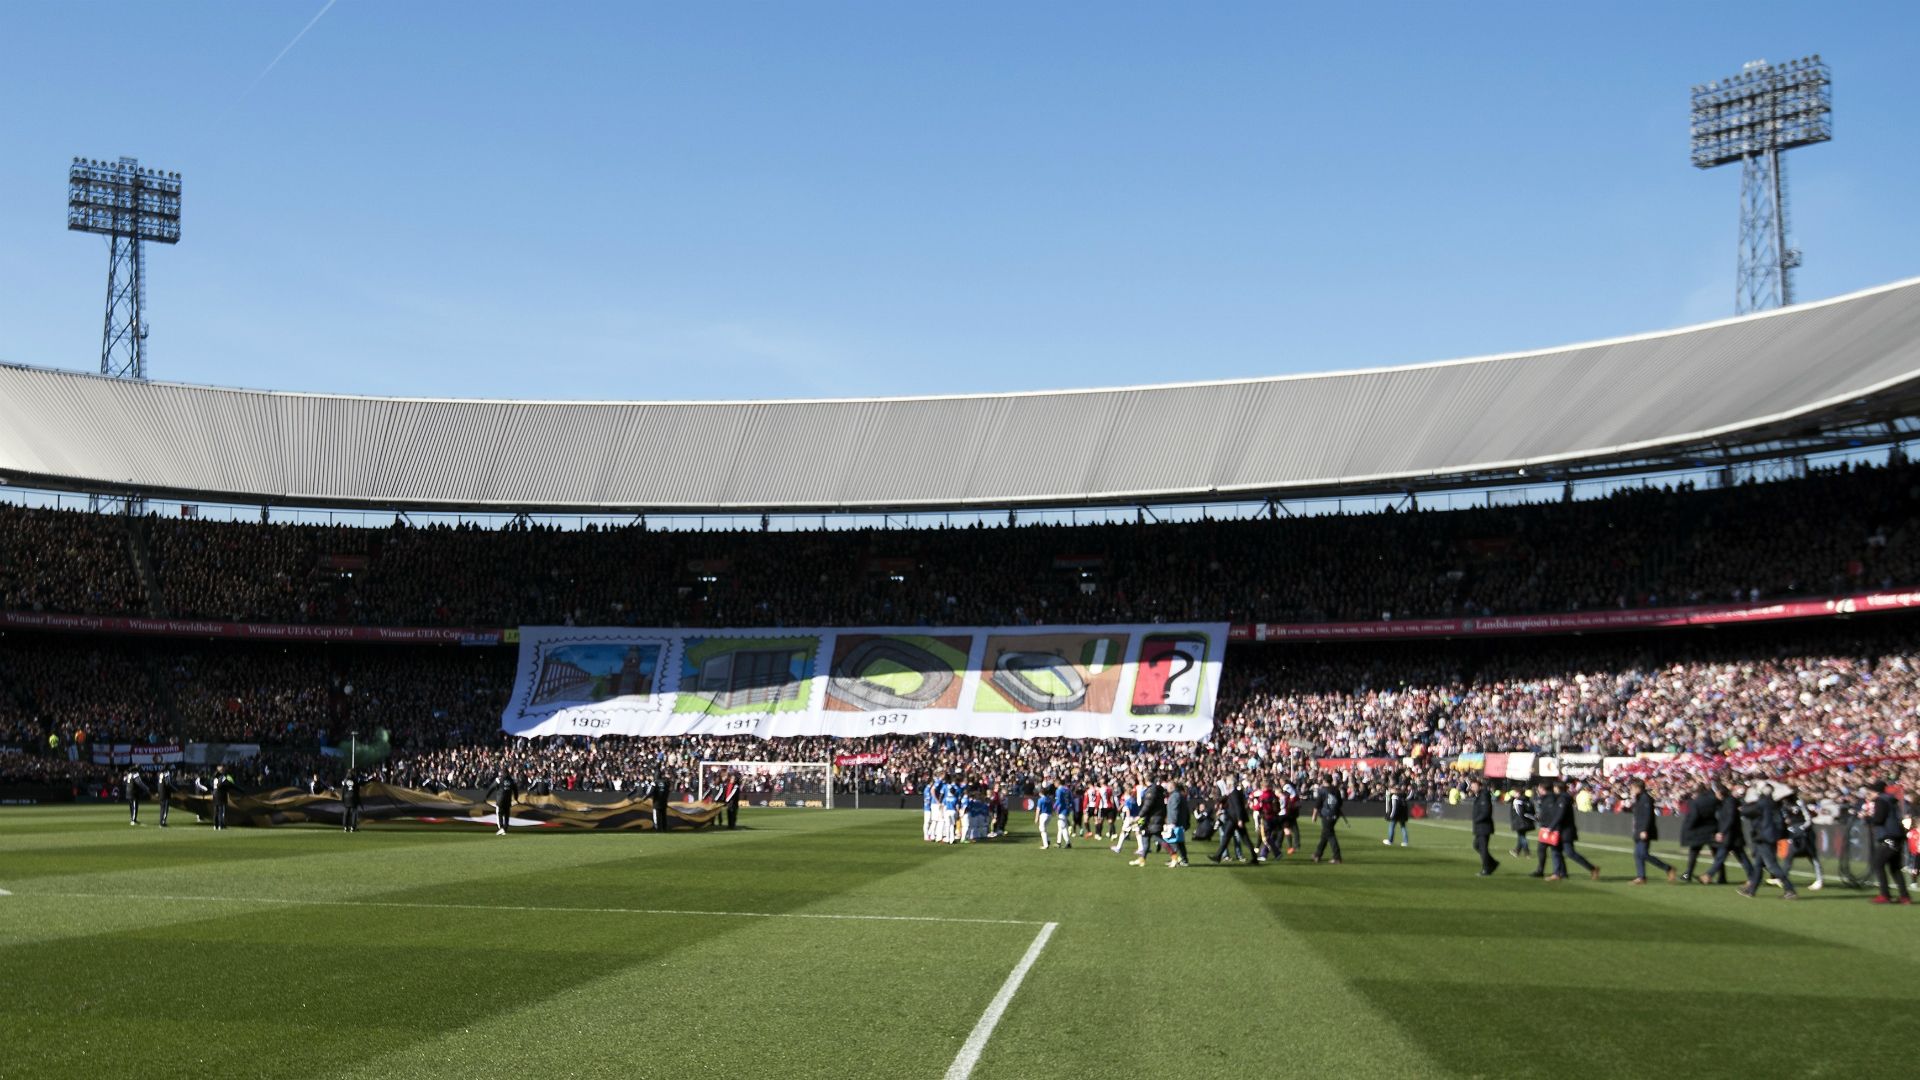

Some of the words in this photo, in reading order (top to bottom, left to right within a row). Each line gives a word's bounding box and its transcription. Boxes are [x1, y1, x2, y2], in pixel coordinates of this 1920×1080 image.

[6, 612, 45, 624] Winnaar
[46, 616, 79, 628] Europa
[129, 619, 166, 631] Winnaar
[168, 621, 224, 633] Wereldbeker
[248, 625, 286, 635] Winnaar
[287, 626, 312, 636] UEFA
[314, 627, 332, 639] Cup
[379, 629, 415, 639] Winnaar
[417, 629, 441, 639] UEFA
[443, 630, 461, 642] Cup
[726, 718, 760, 730] 1917
[869, 713, 909, 727] 1937
[1021, 716, 1062, 731] 1994
[134, 746, 180, 754] FEYENOORD
[141, 764, 177, 772] VICTOA
